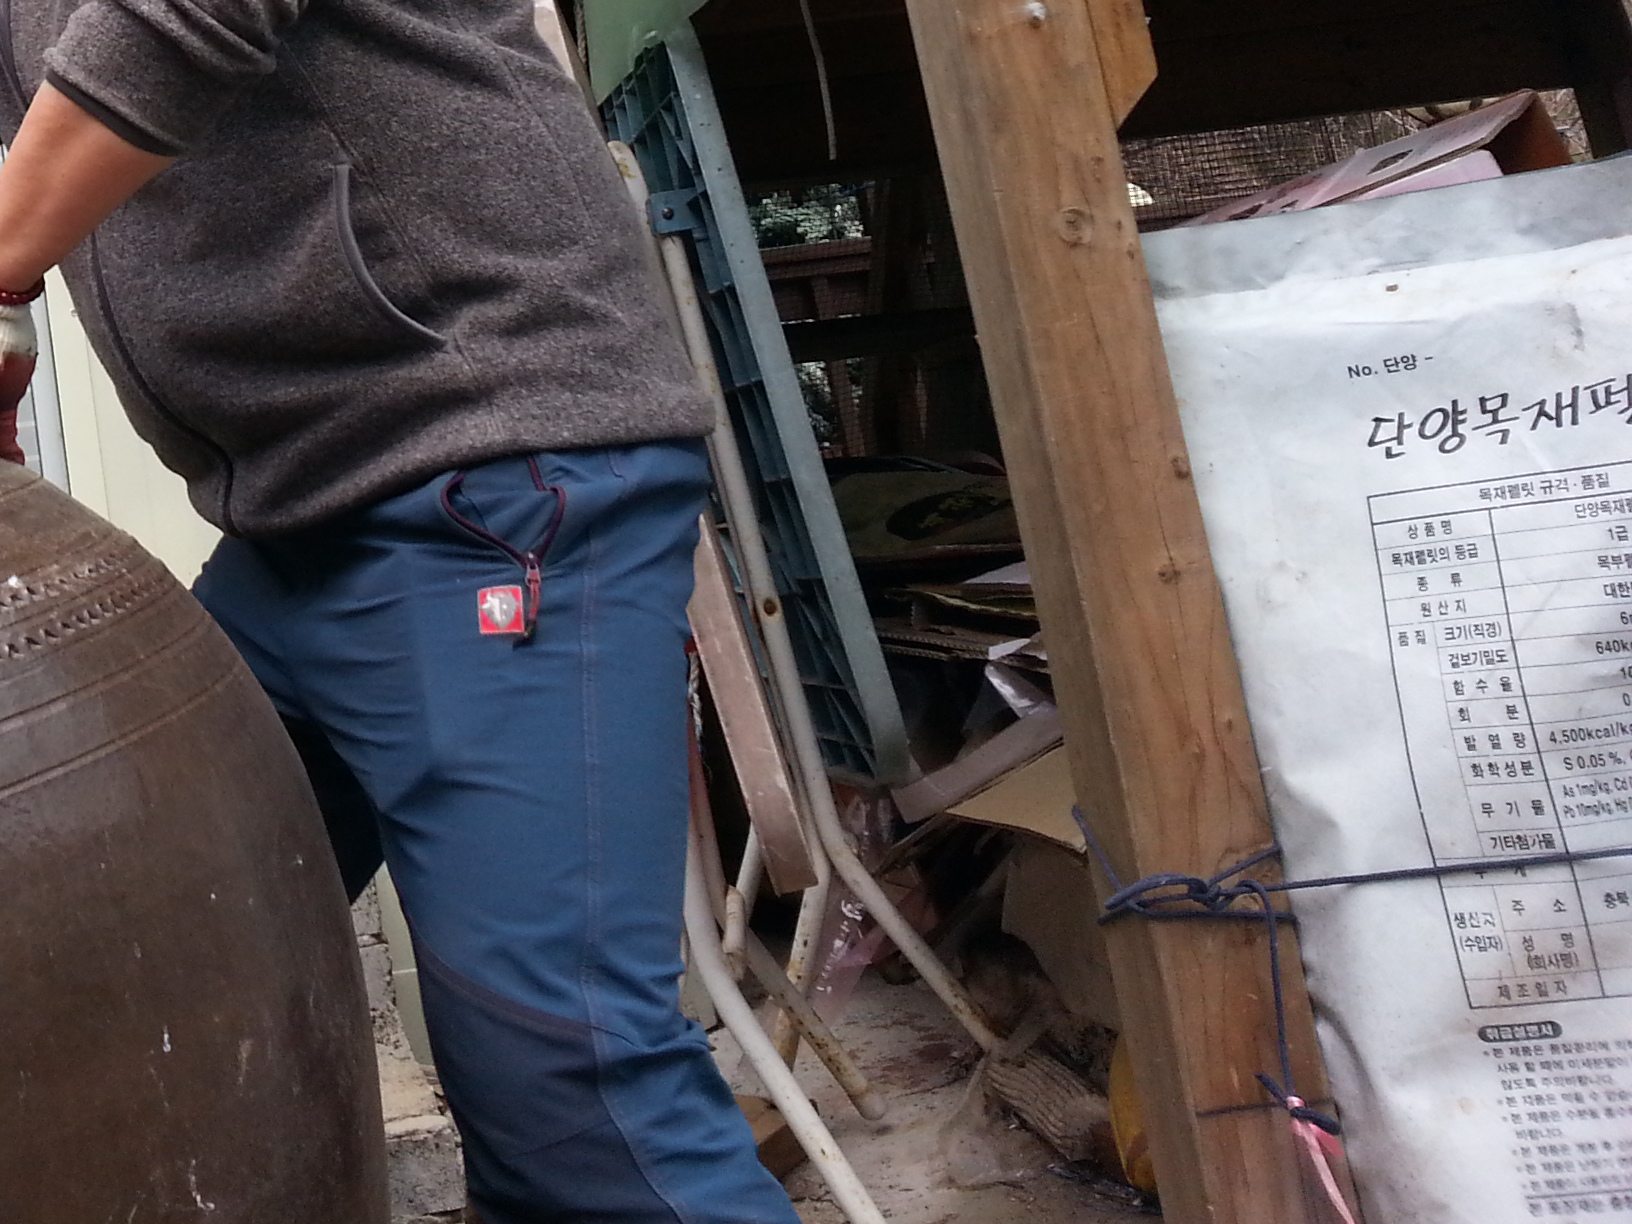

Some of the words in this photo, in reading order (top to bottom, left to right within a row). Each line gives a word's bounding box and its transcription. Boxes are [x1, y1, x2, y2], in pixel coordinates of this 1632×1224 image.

[1347, 365, 1378, 378] No.
[1383, 354, 1418, 374] 단양
[1540, 478, 1570, 497] 규격
[1581, 473, 1610, 491] 품질
[1455, 542, 1479, 562] 등급
[1607, 525, 1629, 541] 1급
[1603, 581, 1632, 599] 대한
[1444, 621, 1502, 642] 크기(직경)
[1595, 639, 1632, 655] 640k
[1577, 754, 1606, 769] 0.05
[1459, 935, 1503, 952] (수입자)
